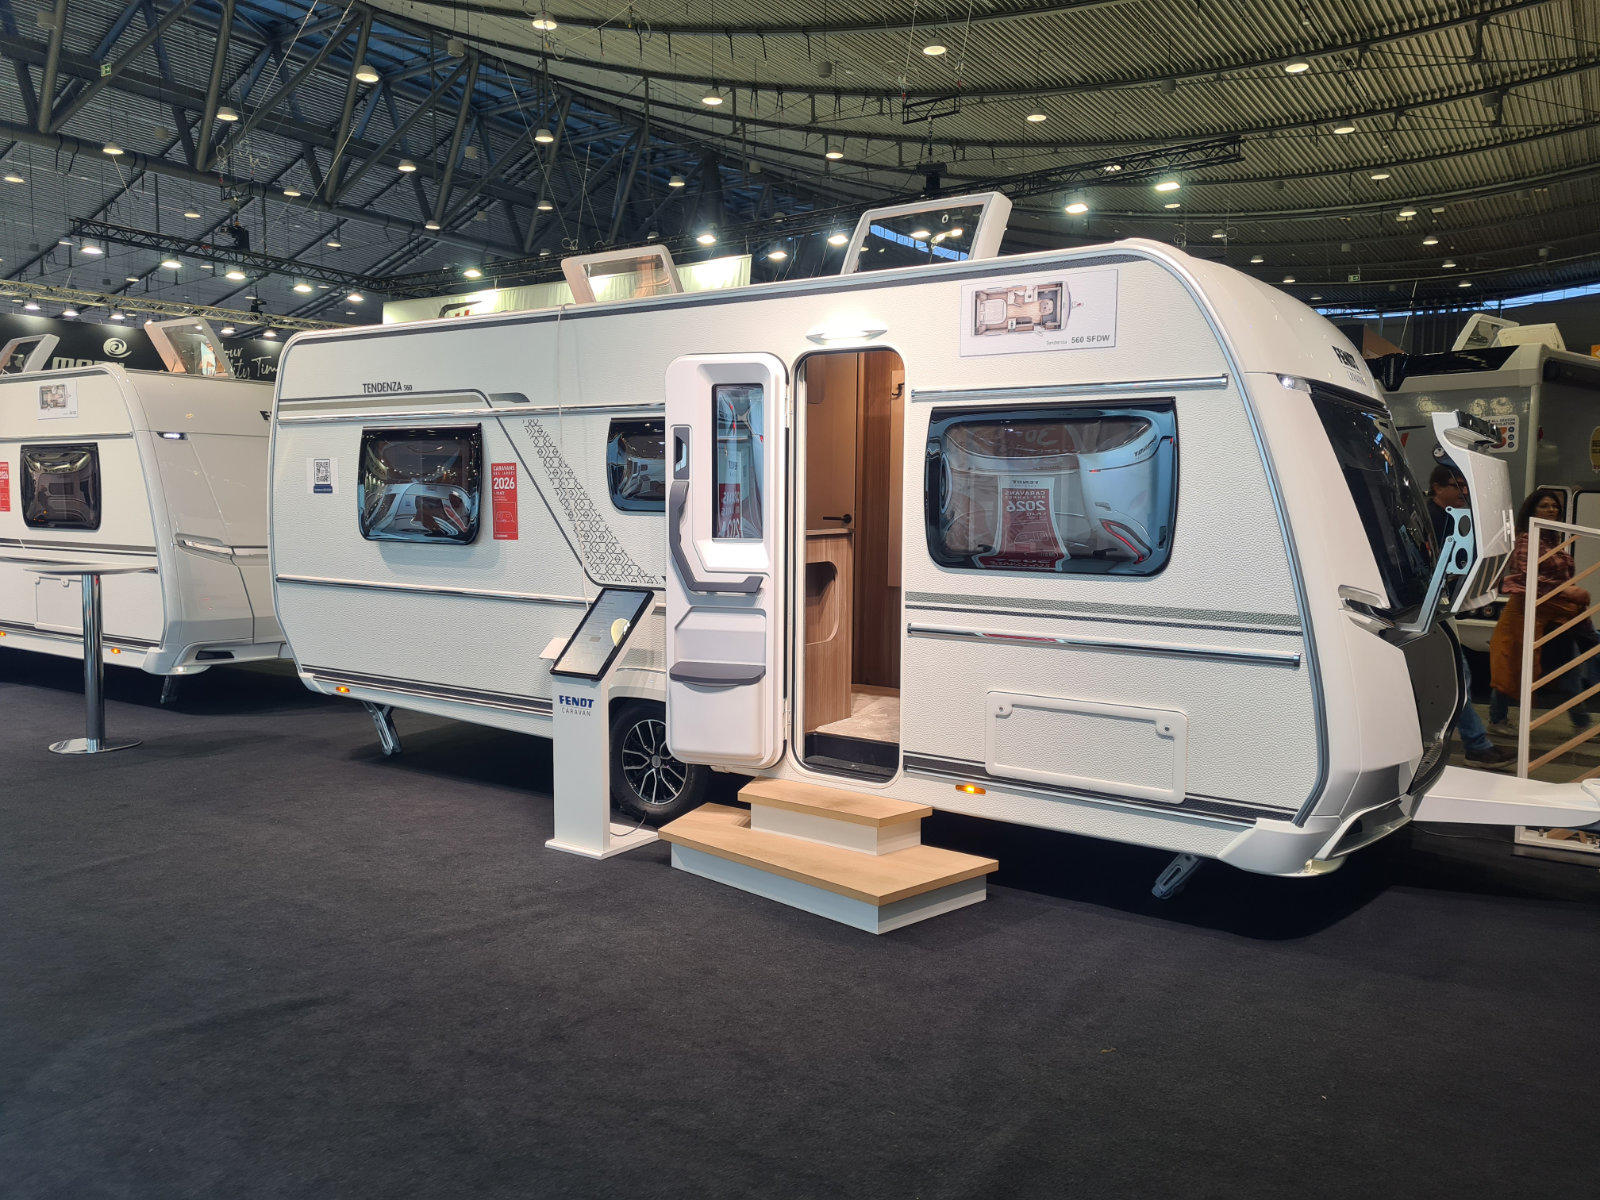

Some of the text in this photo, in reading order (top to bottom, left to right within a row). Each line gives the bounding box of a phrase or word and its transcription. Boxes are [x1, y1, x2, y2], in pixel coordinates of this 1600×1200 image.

[1071, 336, 1084, 344] 560
[1086, 334, 1111, 343] SFDW
[362, 381, 403, 393] TENDENZA
[493, 477, 515, 490] 2026
[558, 694, 594, 709] FENDT
[561, 706, 591, 717] CARAVAN
